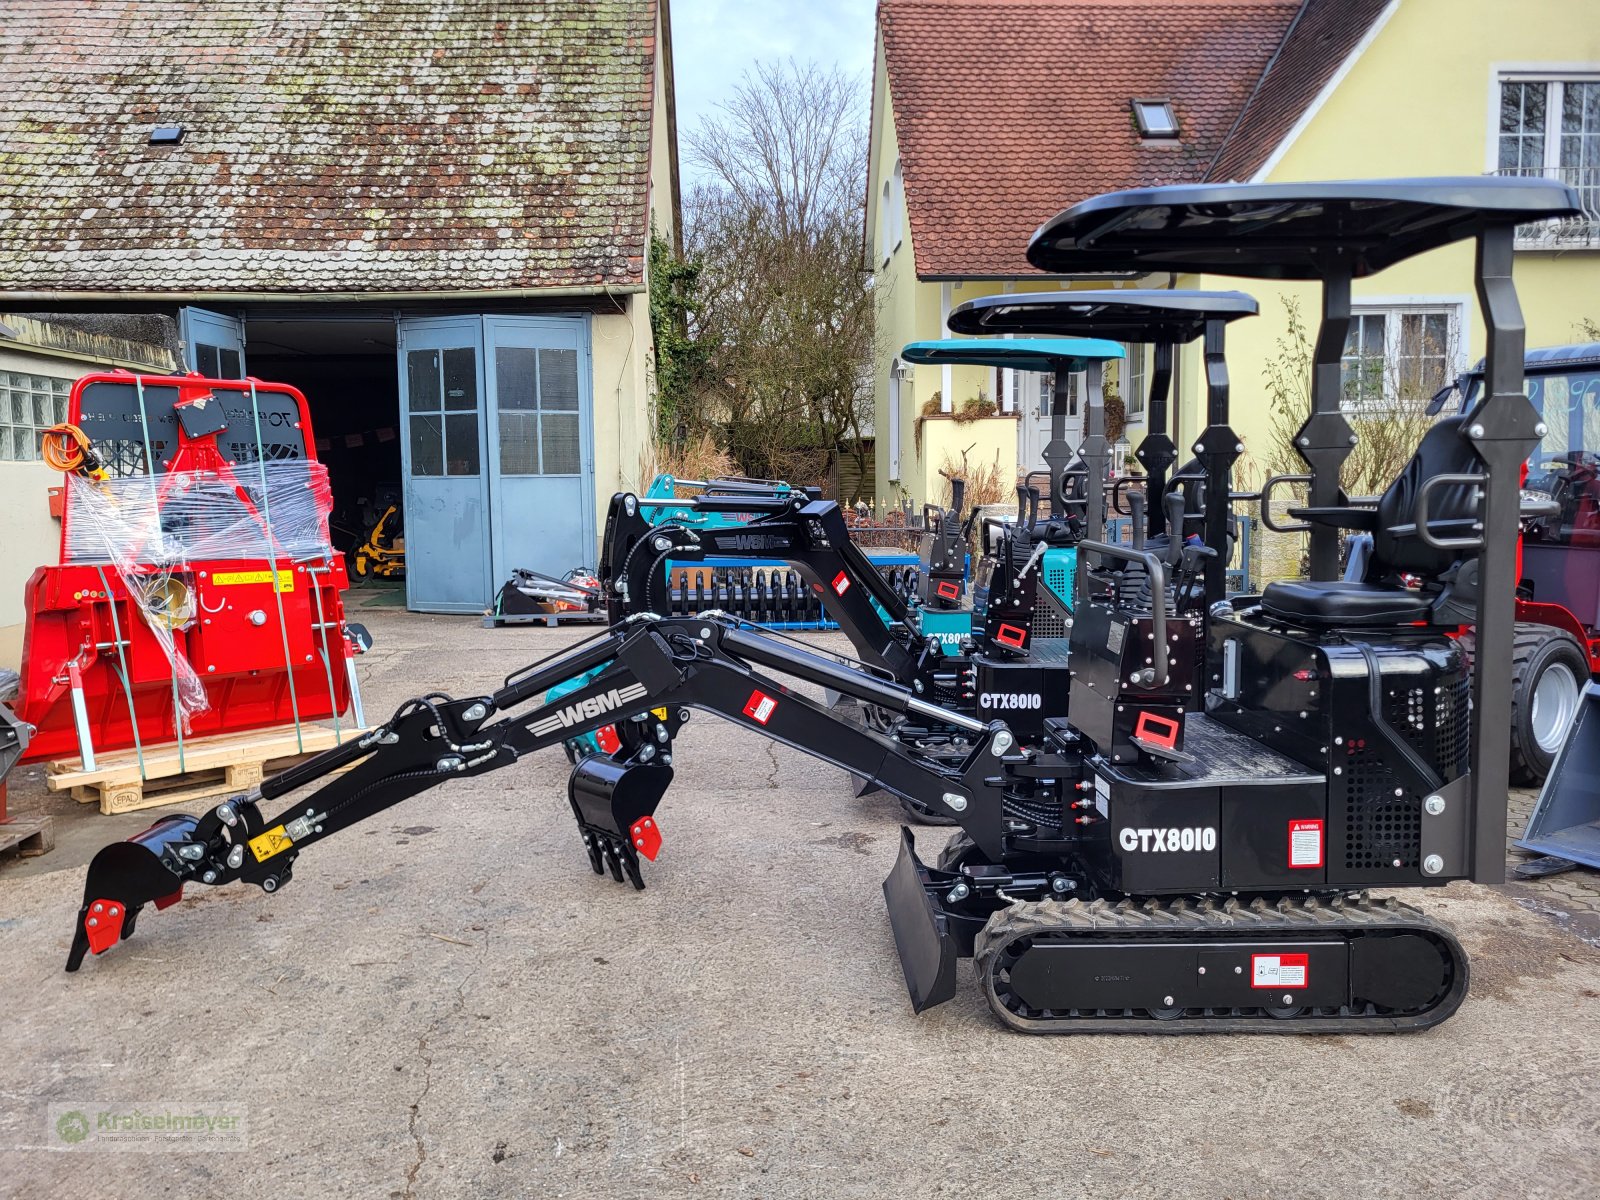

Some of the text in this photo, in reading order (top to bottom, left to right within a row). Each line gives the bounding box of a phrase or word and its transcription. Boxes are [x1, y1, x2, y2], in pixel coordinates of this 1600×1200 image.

[735, 534, 775, 550] WSM
[556, 688, 623, 728] WSM
[980, 692, 1041, 709] CTX8010
[116, 794, 134, 805] EPAL
[1119, 827, 1217, 853] CTX8010
